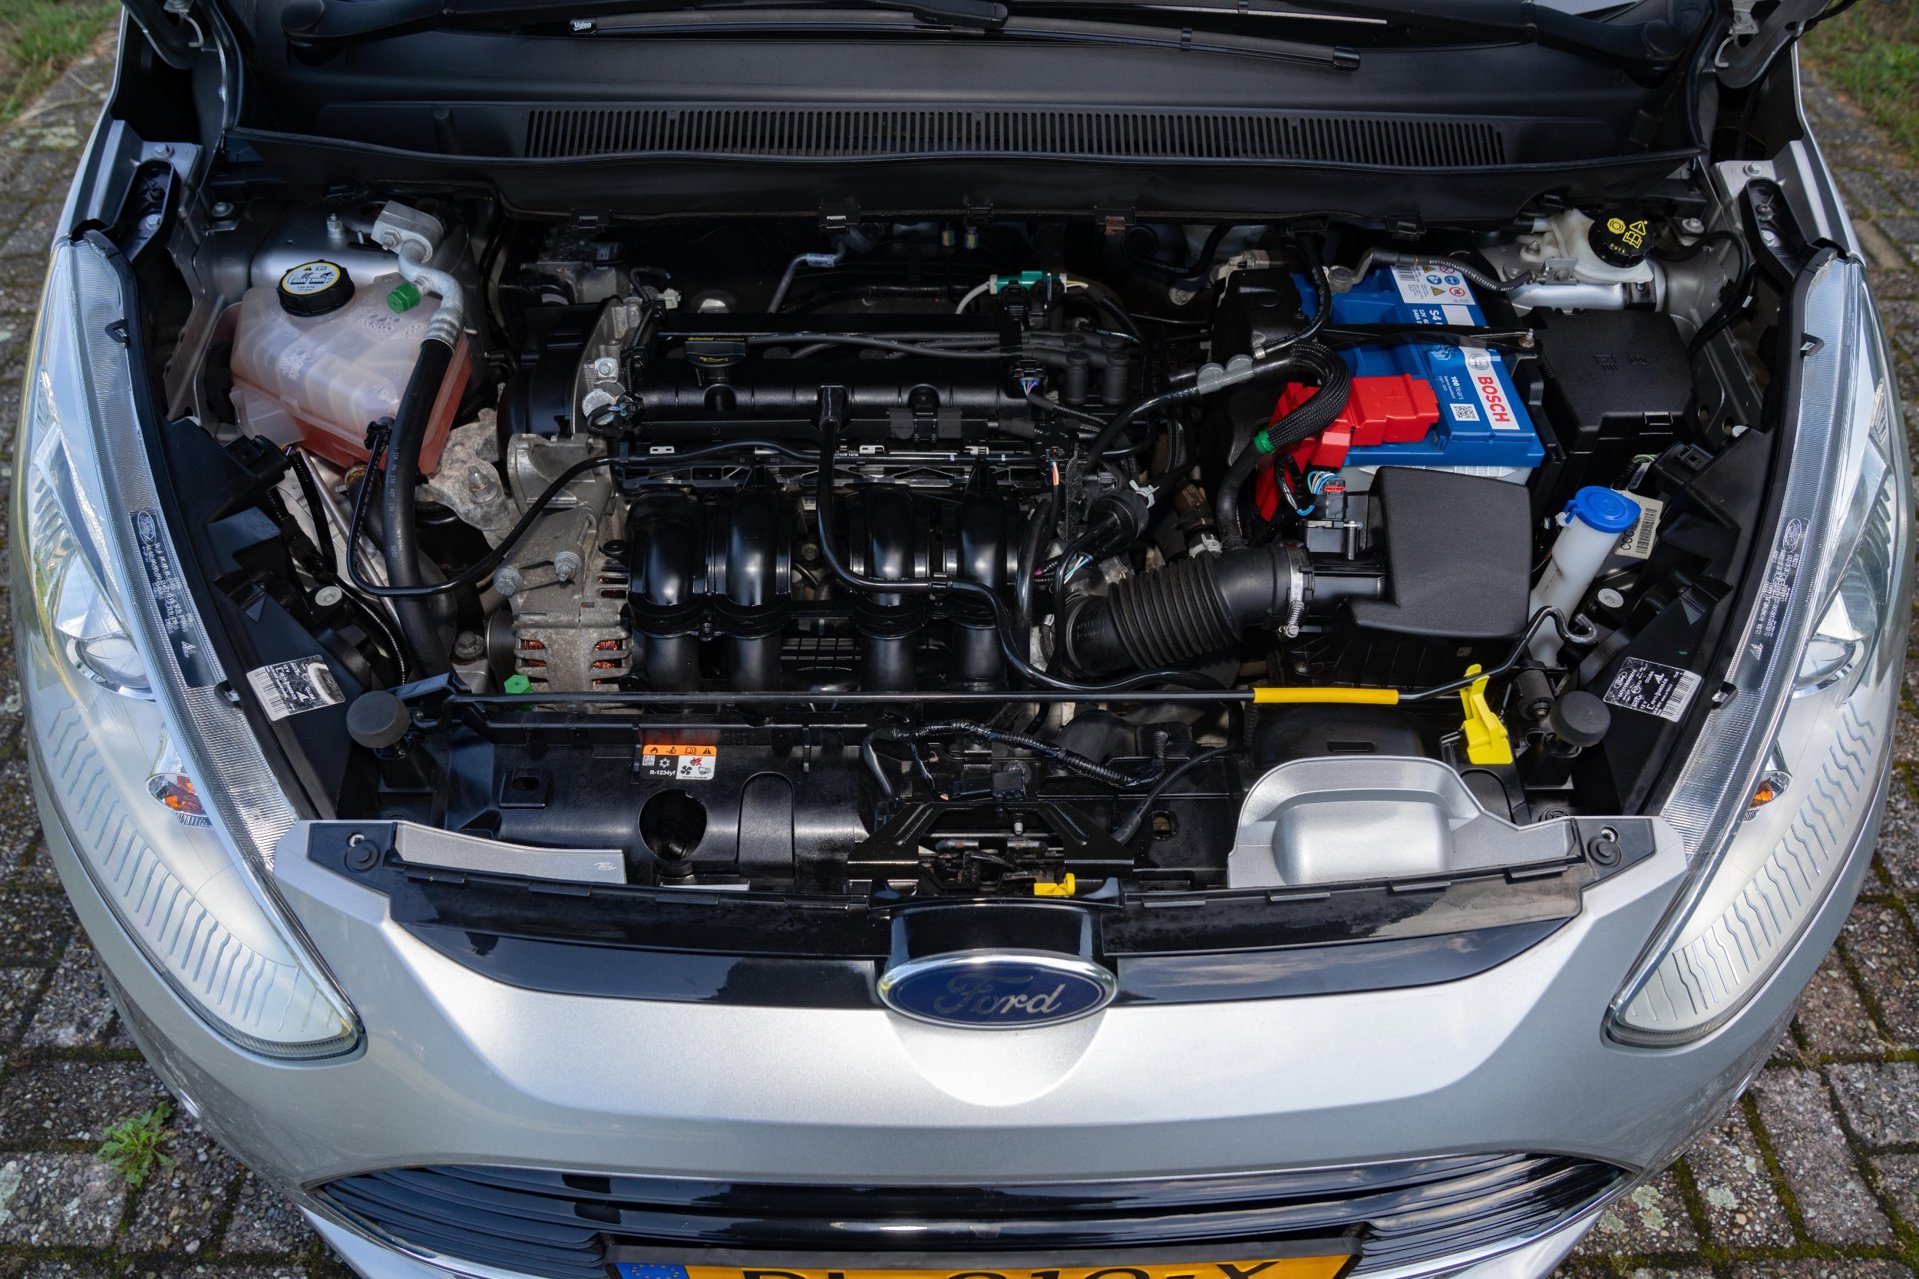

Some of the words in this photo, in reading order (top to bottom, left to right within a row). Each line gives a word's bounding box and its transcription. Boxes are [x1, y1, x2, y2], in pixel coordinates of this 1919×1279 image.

[1477, 376, 1511, 423] BOSCH
[649, 769, 677, 777] R-1234yf
[933, 974, 1067, 1015] Ford
